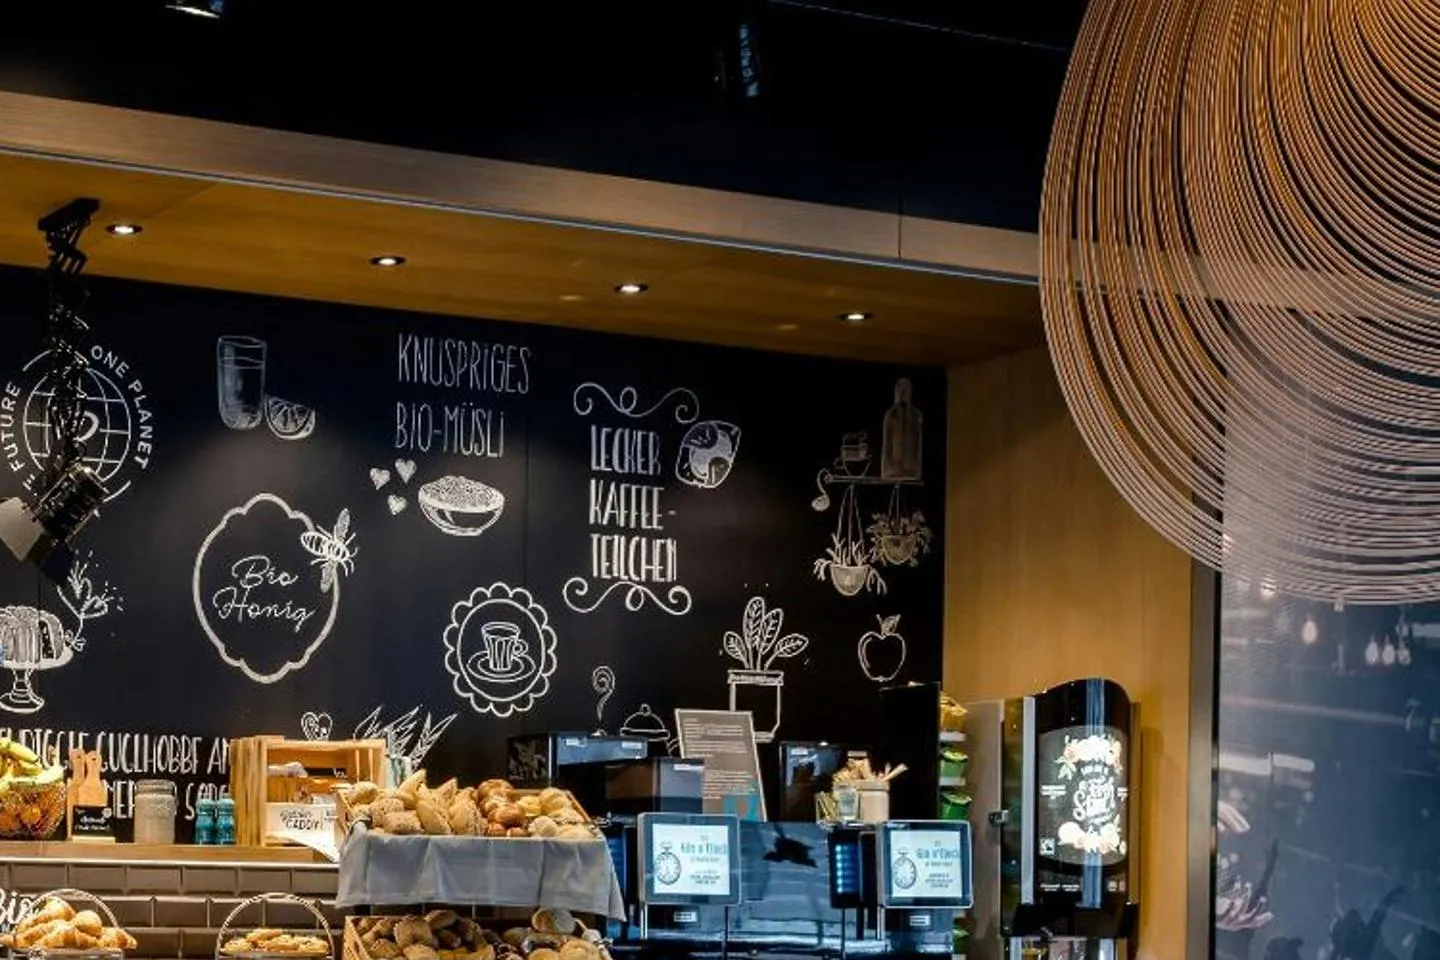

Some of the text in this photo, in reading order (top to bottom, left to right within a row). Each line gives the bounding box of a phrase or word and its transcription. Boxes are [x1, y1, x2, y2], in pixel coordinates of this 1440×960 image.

[398, 333, 532, 395] KNUSPRIGES
[0, 381, 26, 472] FUTURE
[90, 345, 153, 470] ONE PLANET
[396, 401, 505, 458] BIO-MÜSLI
[232, 555, 299, 589] Bio
[589, 534, 677, 583] TEILCHEN
[213, 587, 316, 633] Honig
